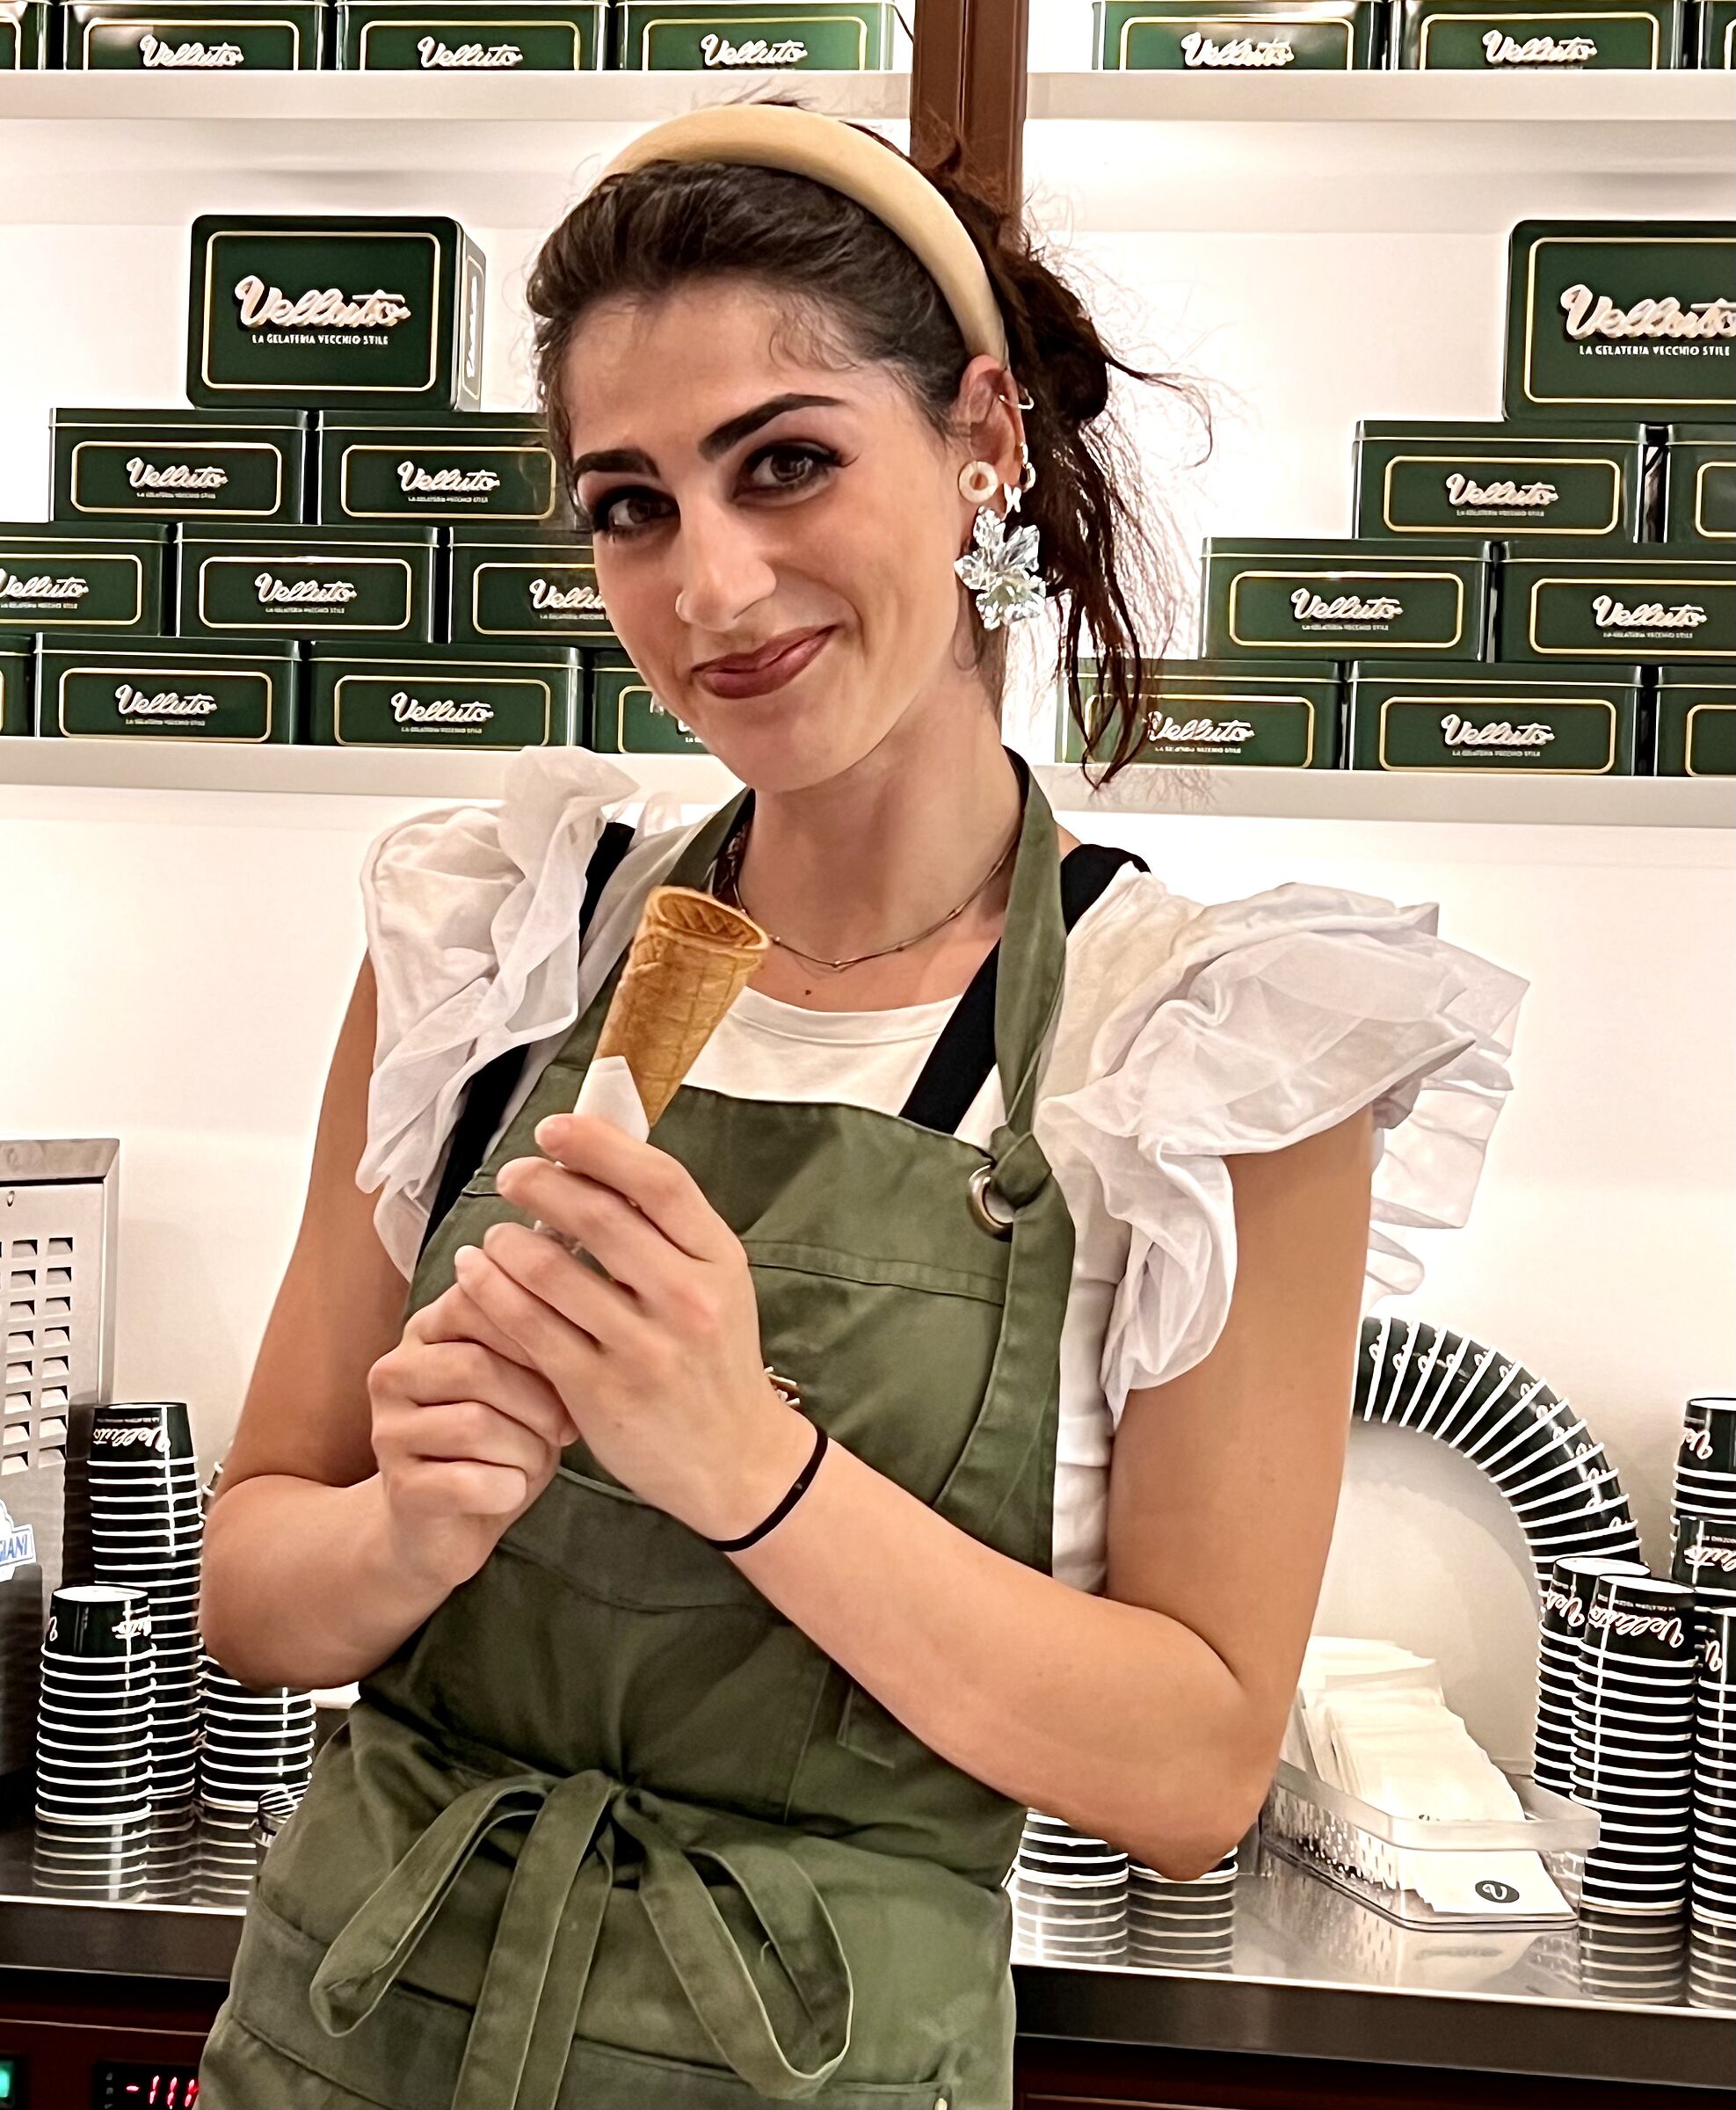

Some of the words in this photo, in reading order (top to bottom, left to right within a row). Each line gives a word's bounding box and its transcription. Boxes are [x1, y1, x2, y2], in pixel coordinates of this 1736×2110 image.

[139, 34, 244, 67] Velluto
[417, 36, 523, 68] Velluto
[701, 34, 808, 66] Velluto
[1180, 31, 1295, 67] Velluto
[1483, 29, 1597, 63] Velluto
[235, 274, 411, 328] Velluto
[251, 334, 265, 345] LA
[266, 333, 316, 345] GELATERIA
[318, 334, 361, 345] VECCHIO
[363, 335, 389, 346] STILE
[1579, 345, 1593, 356] LA
[1595, 345, 1650, 356] GELATERIA
[1652, 346, 1700, 356] VECCHIO
[1703, 346, 1730, 357] STILE
[126, 456, 229, 489] Velluto
[397, 461, 500, 491] Velluto
[1445, 473, 1559, 506] Velluto
[254, 572, 358, 602] Velluto
[1290, 587, 1404, 619] Velluto
[1592, 594, 1708, 627] Velluto
[115, 684, 218, 716] Velluto
[390, 691, 494, 722] Velluto
[1143, 710, 1255, 741] Velluto
[1441, 713, 1556, 746] Velluto
[92, 1427, 171, 1452] Velluto
[1587, 1604, 1685, 1648] Velluto
